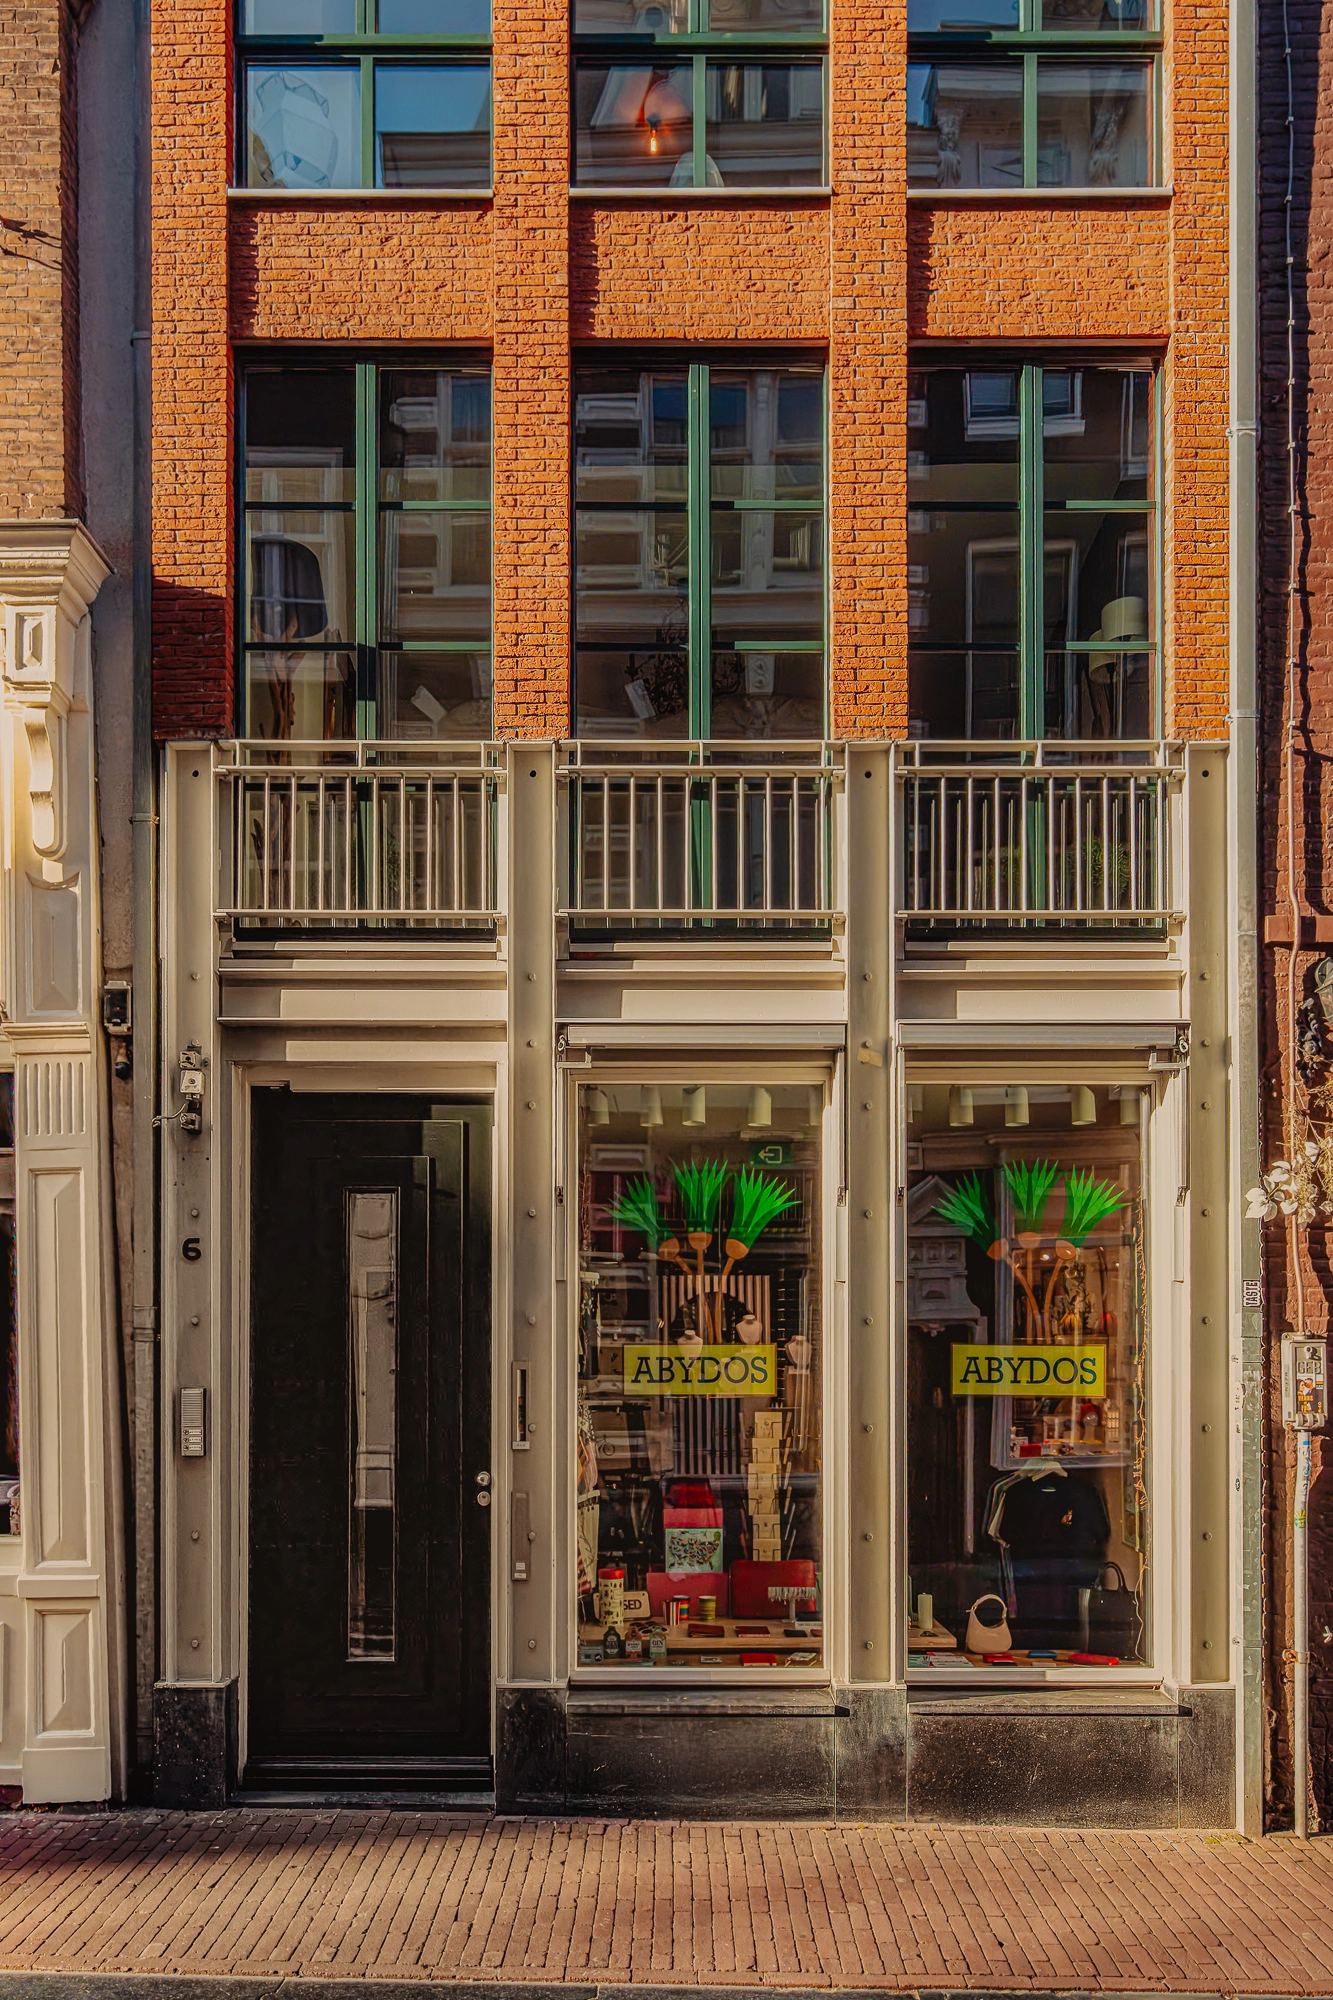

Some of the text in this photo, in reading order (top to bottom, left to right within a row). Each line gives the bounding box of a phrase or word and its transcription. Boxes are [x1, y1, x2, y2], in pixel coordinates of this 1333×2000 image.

[182, 1238, 202, 1261] 6
[1245, 1281, 1258, 1306] TASTE
[631, 1355, 769, 1384] ABYDOS
[959, 1356, 1098, 1385] ABYDOS
[623, 1599, 642, 1610] SED
